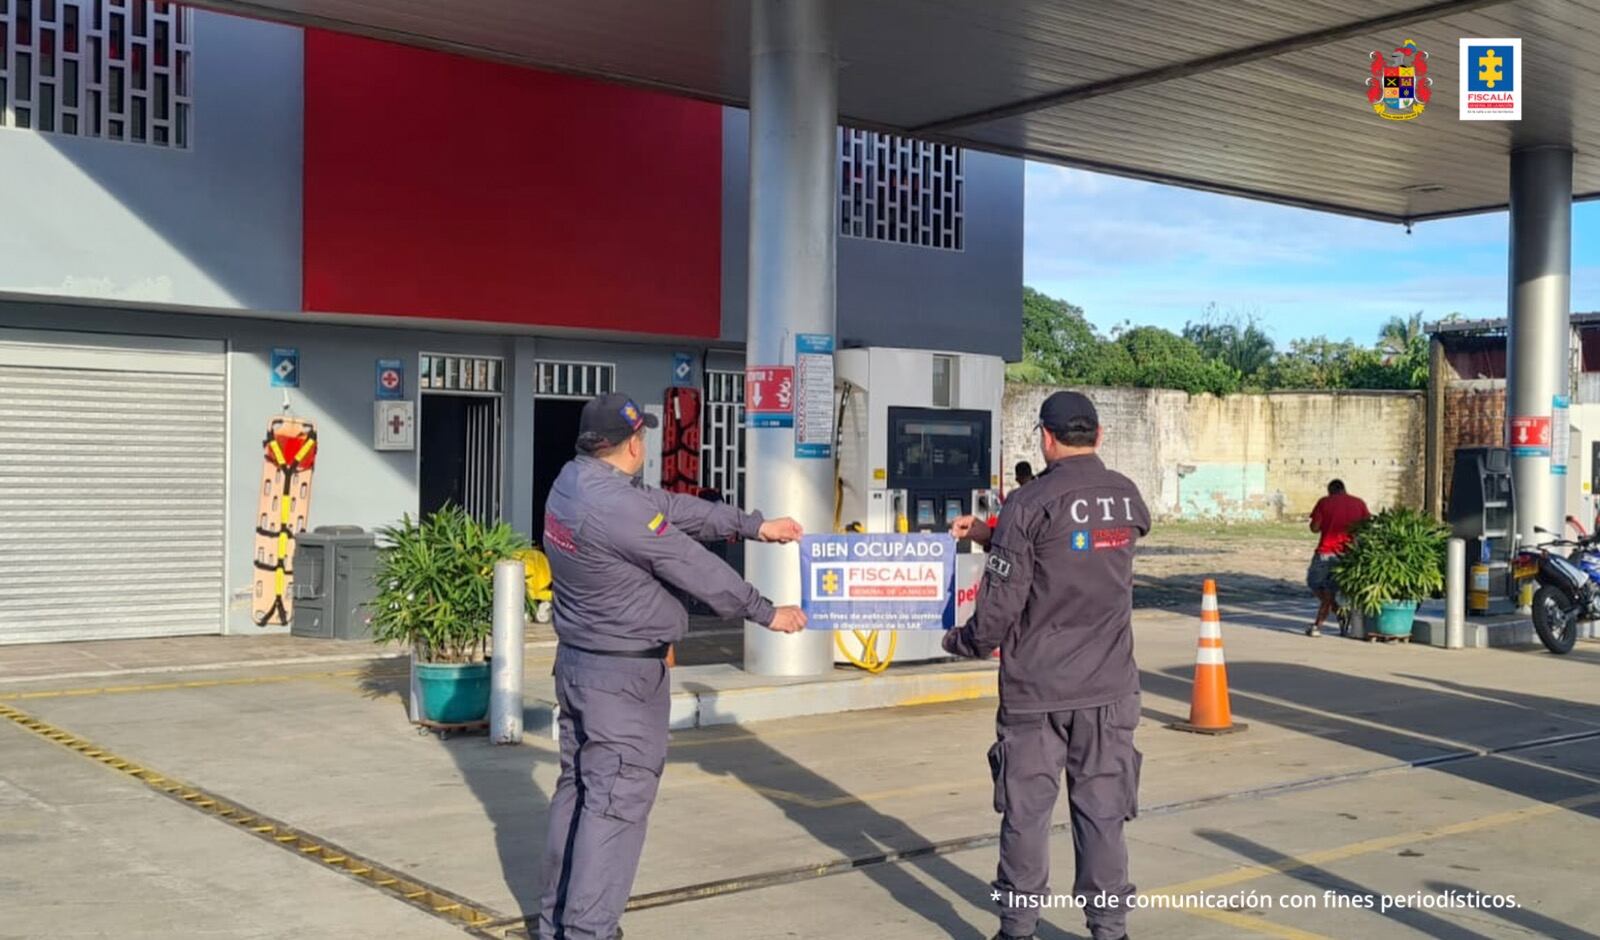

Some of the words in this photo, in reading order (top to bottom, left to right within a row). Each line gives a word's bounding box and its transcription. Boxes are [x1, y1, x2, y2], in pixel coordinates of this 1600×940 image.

[1070, 497, 1133, 524] CTI
[811, 542, 848, 557] BIEN
[854, 541, 944, 557] OCUPADO
[849, 566, 937, 581] FISCALÍA
[988, 555, 1012, 577] CTI
[830, 612, 848, 620] fines
